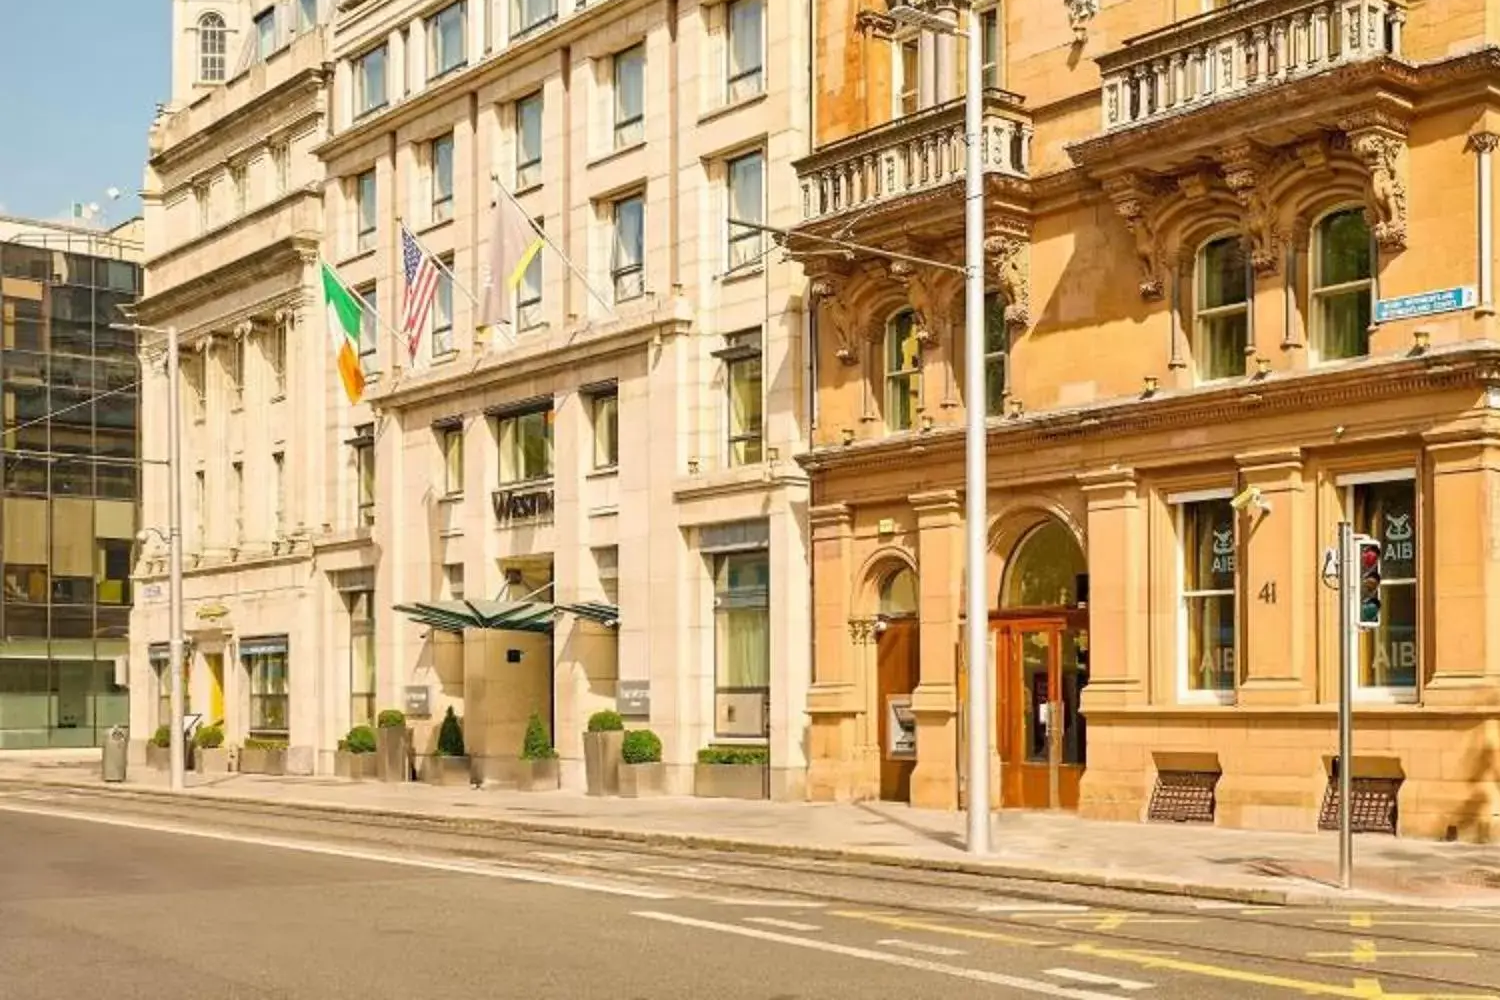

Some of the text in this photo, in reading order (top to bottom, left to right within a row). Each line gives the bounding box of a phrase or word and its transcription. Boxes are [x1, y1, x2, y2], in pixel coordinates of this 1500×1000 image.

[1383, 543, 1413, 561] AIB
[1258, 581, 1277, 604] 41
[1372, 641, 1416, 669] AIB
